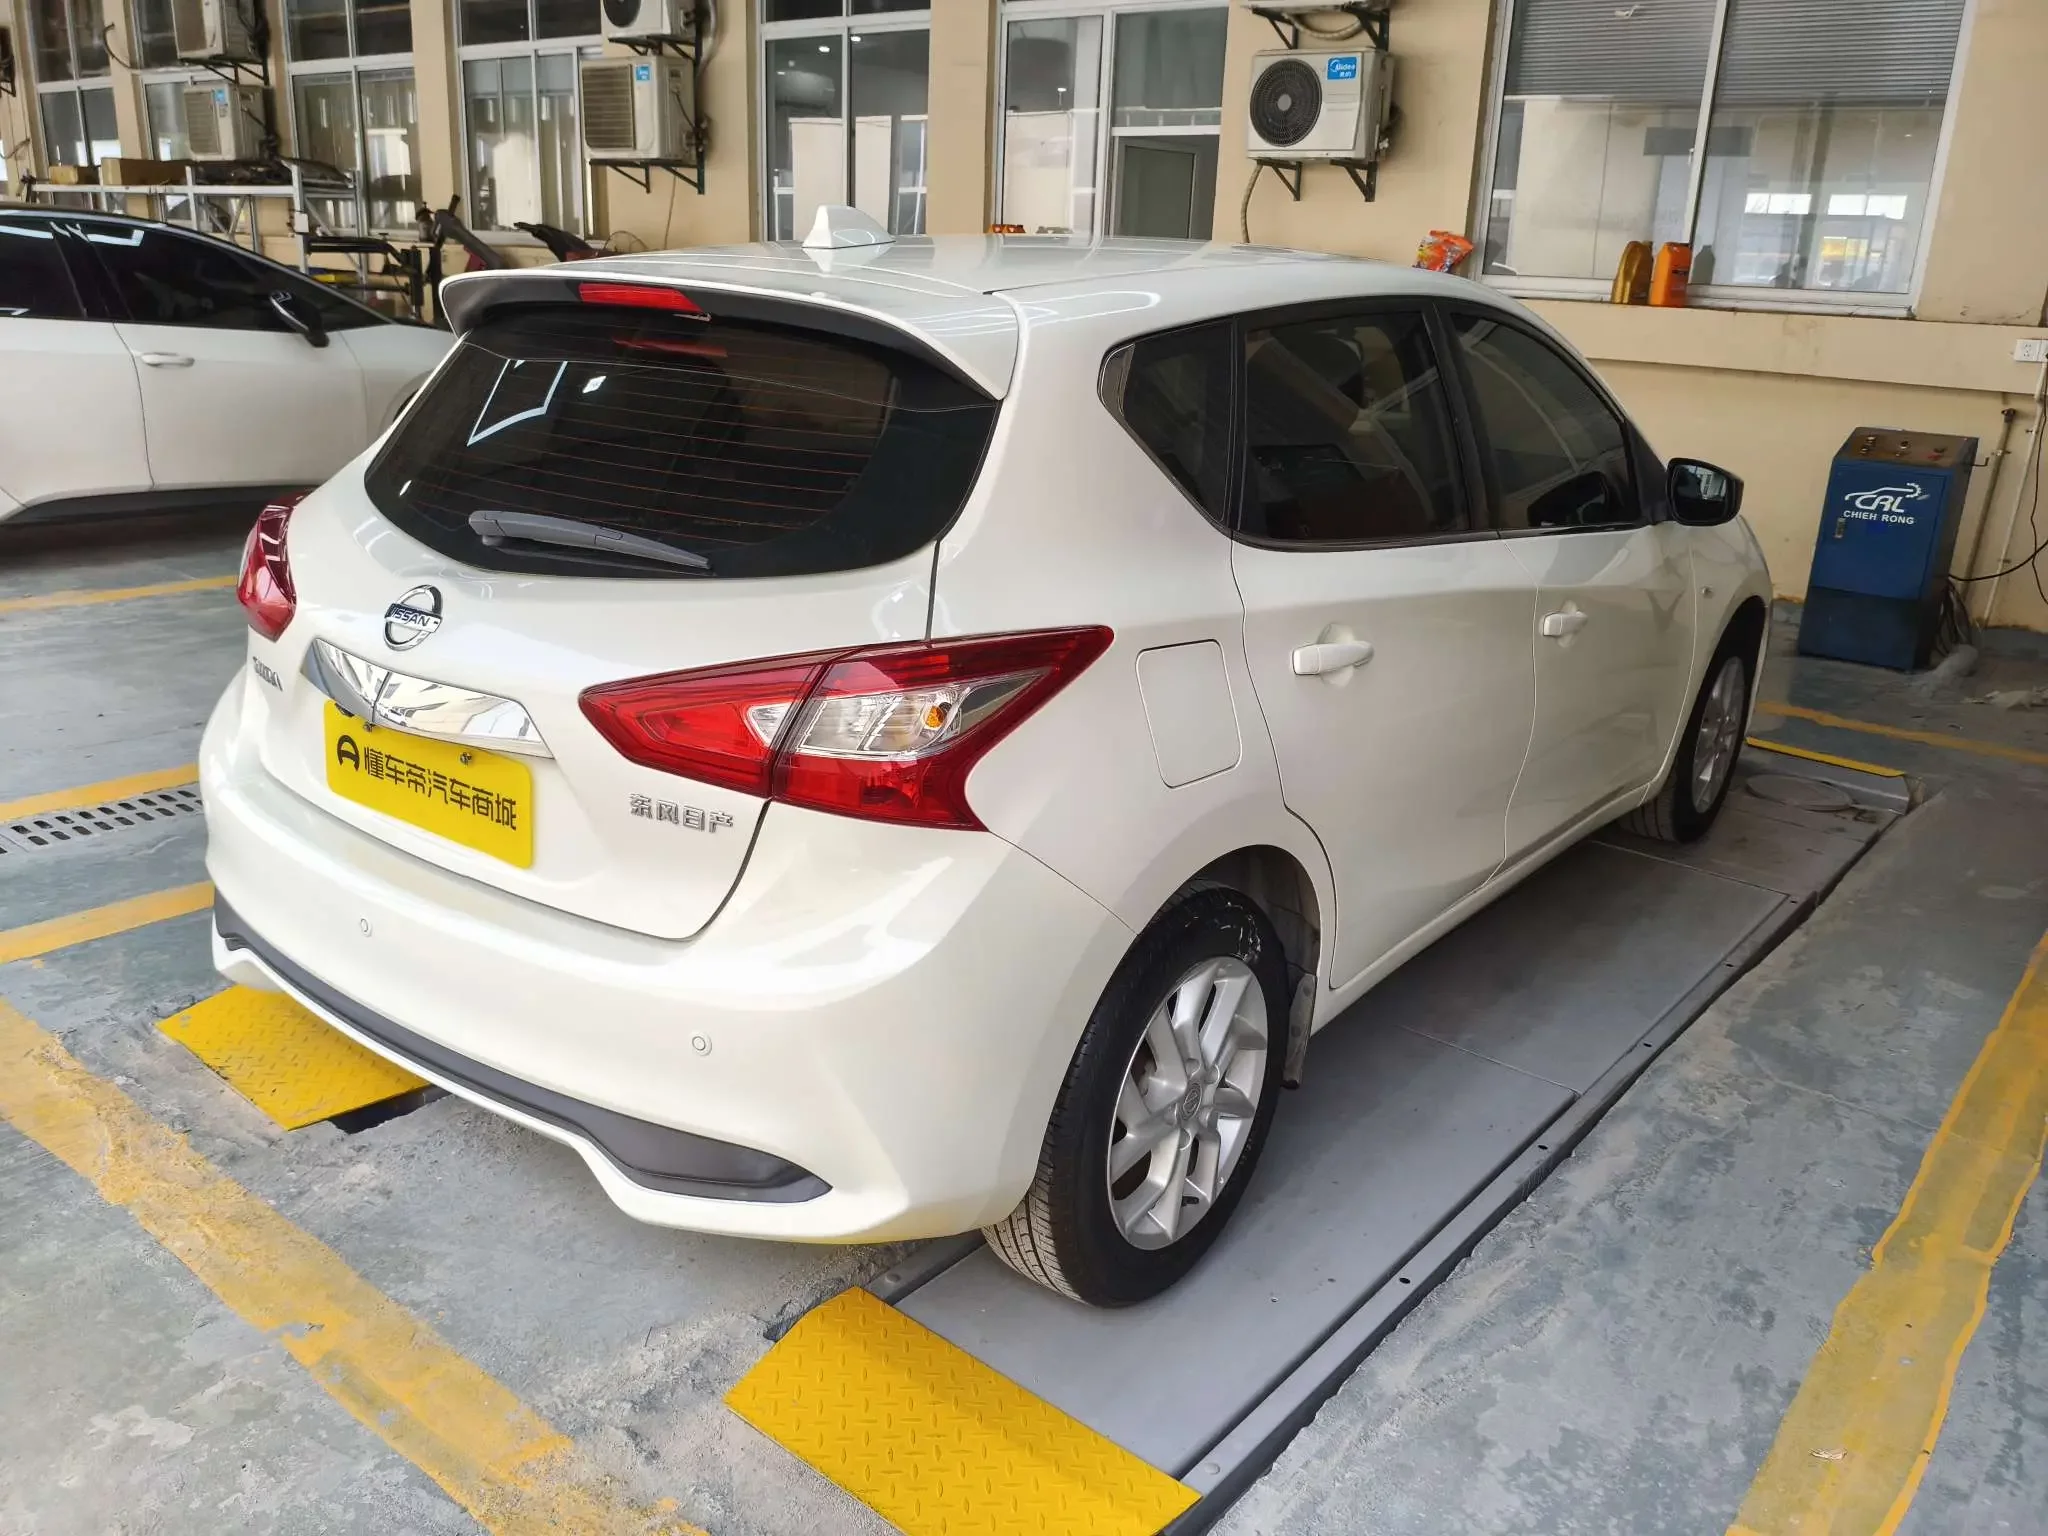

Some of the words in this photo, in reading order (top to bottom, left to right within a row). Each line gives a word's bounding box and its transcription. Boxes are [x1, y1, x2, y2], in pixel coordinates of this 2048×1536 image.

[1843, 510, 1878, 521] CHIEH
[1881, 514, 1915, 525] RONG
[364, 746, 517, 831] 懂车帝汽车商城
[629, 793, 735, 833] 东风日产
